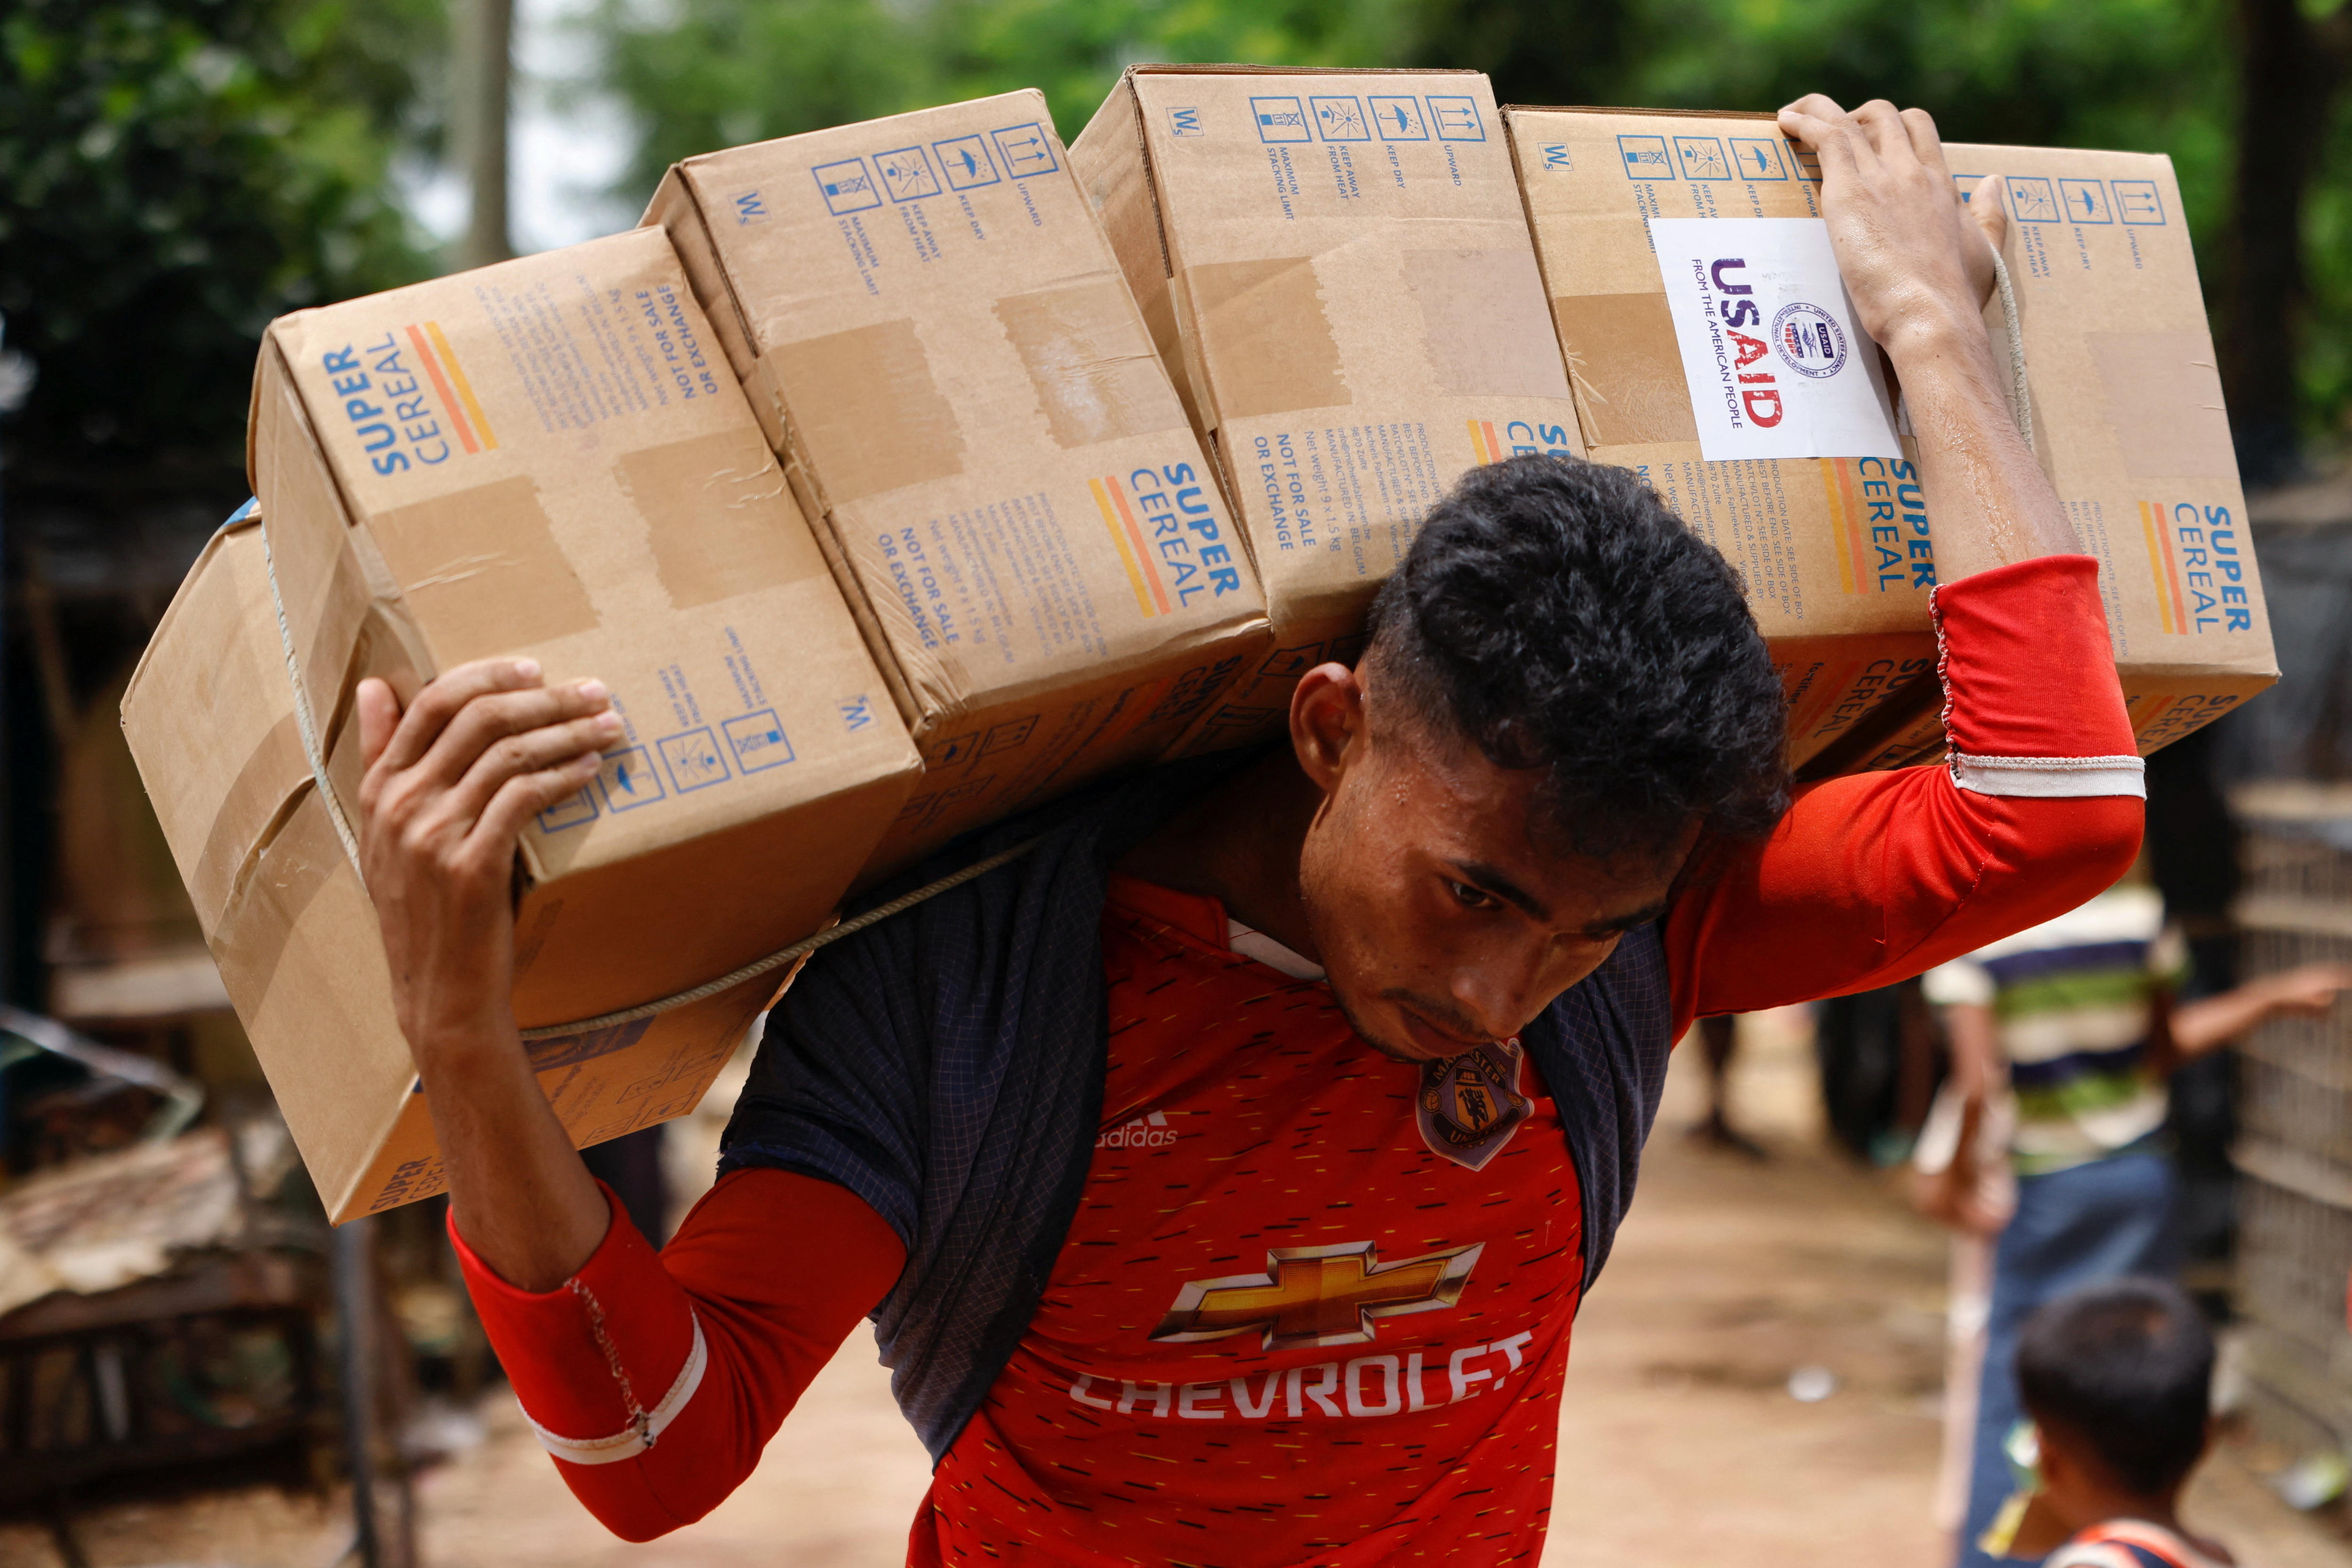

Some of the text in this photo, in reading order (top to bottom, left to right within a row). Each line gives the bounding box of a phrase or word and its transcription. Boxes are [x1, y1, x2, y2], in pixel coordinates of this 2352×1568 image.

[1267, 148, 1294, 220] STACKING LIMIT
[1279, 147, 1299, 194] MAXIMUM
[1327, 146, 1348, 199] FROM HEAT
[1339, 146, 1359, 198] KEEP AWAY
[1386, 145, 1405, 188] KEEP DRY
[1444, 145, 1462, 186] UPWARD
[958, 194, 984, 240] KEEP DRY
[1017, 182, 1042, 226] UPWARD
[1633, 184, 1649, 227] STACKING
[1690, 184, 1703, 209] FROM
[1701, 184, 1714, 204] KEEP
[1747, 185, 1759, 205] KEEP
[839, 220, 878, 295] STACKING LIMIT
[851, 217, 879, 267] MAXIMUM
[899, 206, 930, 262] FROM HEAT
[911, 204, 941, 258] KEEP AWAY
[2021, 226, 2040, 277] FROM HEAT
[2032, 227, 2050, 277] KEEP AWAY
[2074, 228, 2090, 269] KEEP DRY
[2127, 229, 2143, 269] UPWARD
[636, 289, 696, 399] NOT FOR SALE
[657, 285, 718, 394] OR EXCHANGE
[1692, 259, 1742, 429] FROM THE AMERICAN PEOPLE
[1711, 258, 1783, 428] USAID
[1774, 305, 1819, 376] INTERNATIONAL DEVELOPMENT
[1814, 307, 1845, 374] UNITED STATES AGENCY
[1819, 327, 1831, 354] USAID
[323, 344, 411, 476] SUPER
[366, 333, 450, 465] CEREAL
[1304, 430, 1317, 451] Net
[1351, 427, 1368, 470] 9870 Zulte
[1377, 425, 1401, 495] MANUFACTURED
[1402, 423, 1430, 501] BEST BEFORE END:
[1416, 423, 1437, 479] PRODUCTION
[1255, 436, 1293, 550] OR EXCHANGE
[1277, 434, 1315, 546] NOT FOR SALE
[1310, 453, 1328, 492] weight
[1338, 429, 1373, 541] info@michielsfabrieken.be
[1364, 426, 1378, 459] Michiels
[1373, 462, 1389, 503] Fabrieken
[1384, 505, 1392, 515] nv
[1389, 525, 1403, 559] Vincent
[1390, 424, 1423, 525] BATCH/LOT SEE SIDE
[1662, 463, 1675, 483] Net
[1707, 461, 1721, 504] 9870 Zulte
[1757, 459, 1767, 479] BEST
[1769, 459, 1787, 516] PRODUCTION
[1325, 429, 1366, 574] MANUFACTURED IN: BELGIUM
[1720, 461, 1742, 551] Michiels Fabrieken nv
[1732, 460, 1752, 531] MANUFACTURED
[1748, 543, 1762, 585] SUPPLIED
[1762, 482, 1774, 514] BEFORE
[1859, 457, 1905, 592] CEREAL
[1890, 459, 1937, 589] SUPER
[1131, 469, 1204, 608] CEREAL
[1163, 463, 1240, 598] SUPER
[1325, 517, 1338, 533] 1.5
[1329, 537, 1341, 552] kg
[1744, 459, 1776, 598] BATCH/LOT SEE SIDE OF BOX
[1769, 518, 1778, 538] END:
[1781, 519, 1791, 543] DATE:
[2081, 502, 2098, 554] BEST BEFORE
[2093, 502, 2110, 557] PRODUCTION
[878, 533, 938, 649] OR EXCHANGE
[900, 527, 960, 643] NOT FOR SALE
[929, 519, 944, 541] Net
[938, 544, 962, 584] weight
[956, 585, 968, 594] 9
[974, 628, 986, 644] kg
[1776, 559, 1785, 577] SIDE
[1780, 581, 1787, 592] OF
[1789, 564, 1798, 583] SIDE
[1793, 586, 1800, 598] OF
[2175, 503, 2219, 634] CEREAL
[2204, 505, 2251, 633] SUPER
[1782, 596, 1790, 614] BOX
[1795, 602, 1803, 619] BOX
[2117, 625, 2125, 635] OF
[2120, 640, 2128, 657] BOX
[1814, 659, 1895, 738] CEREAL
[2137, 695, 2206, 746] CEREA
[369, 1156, 432, 1210] SUPER
